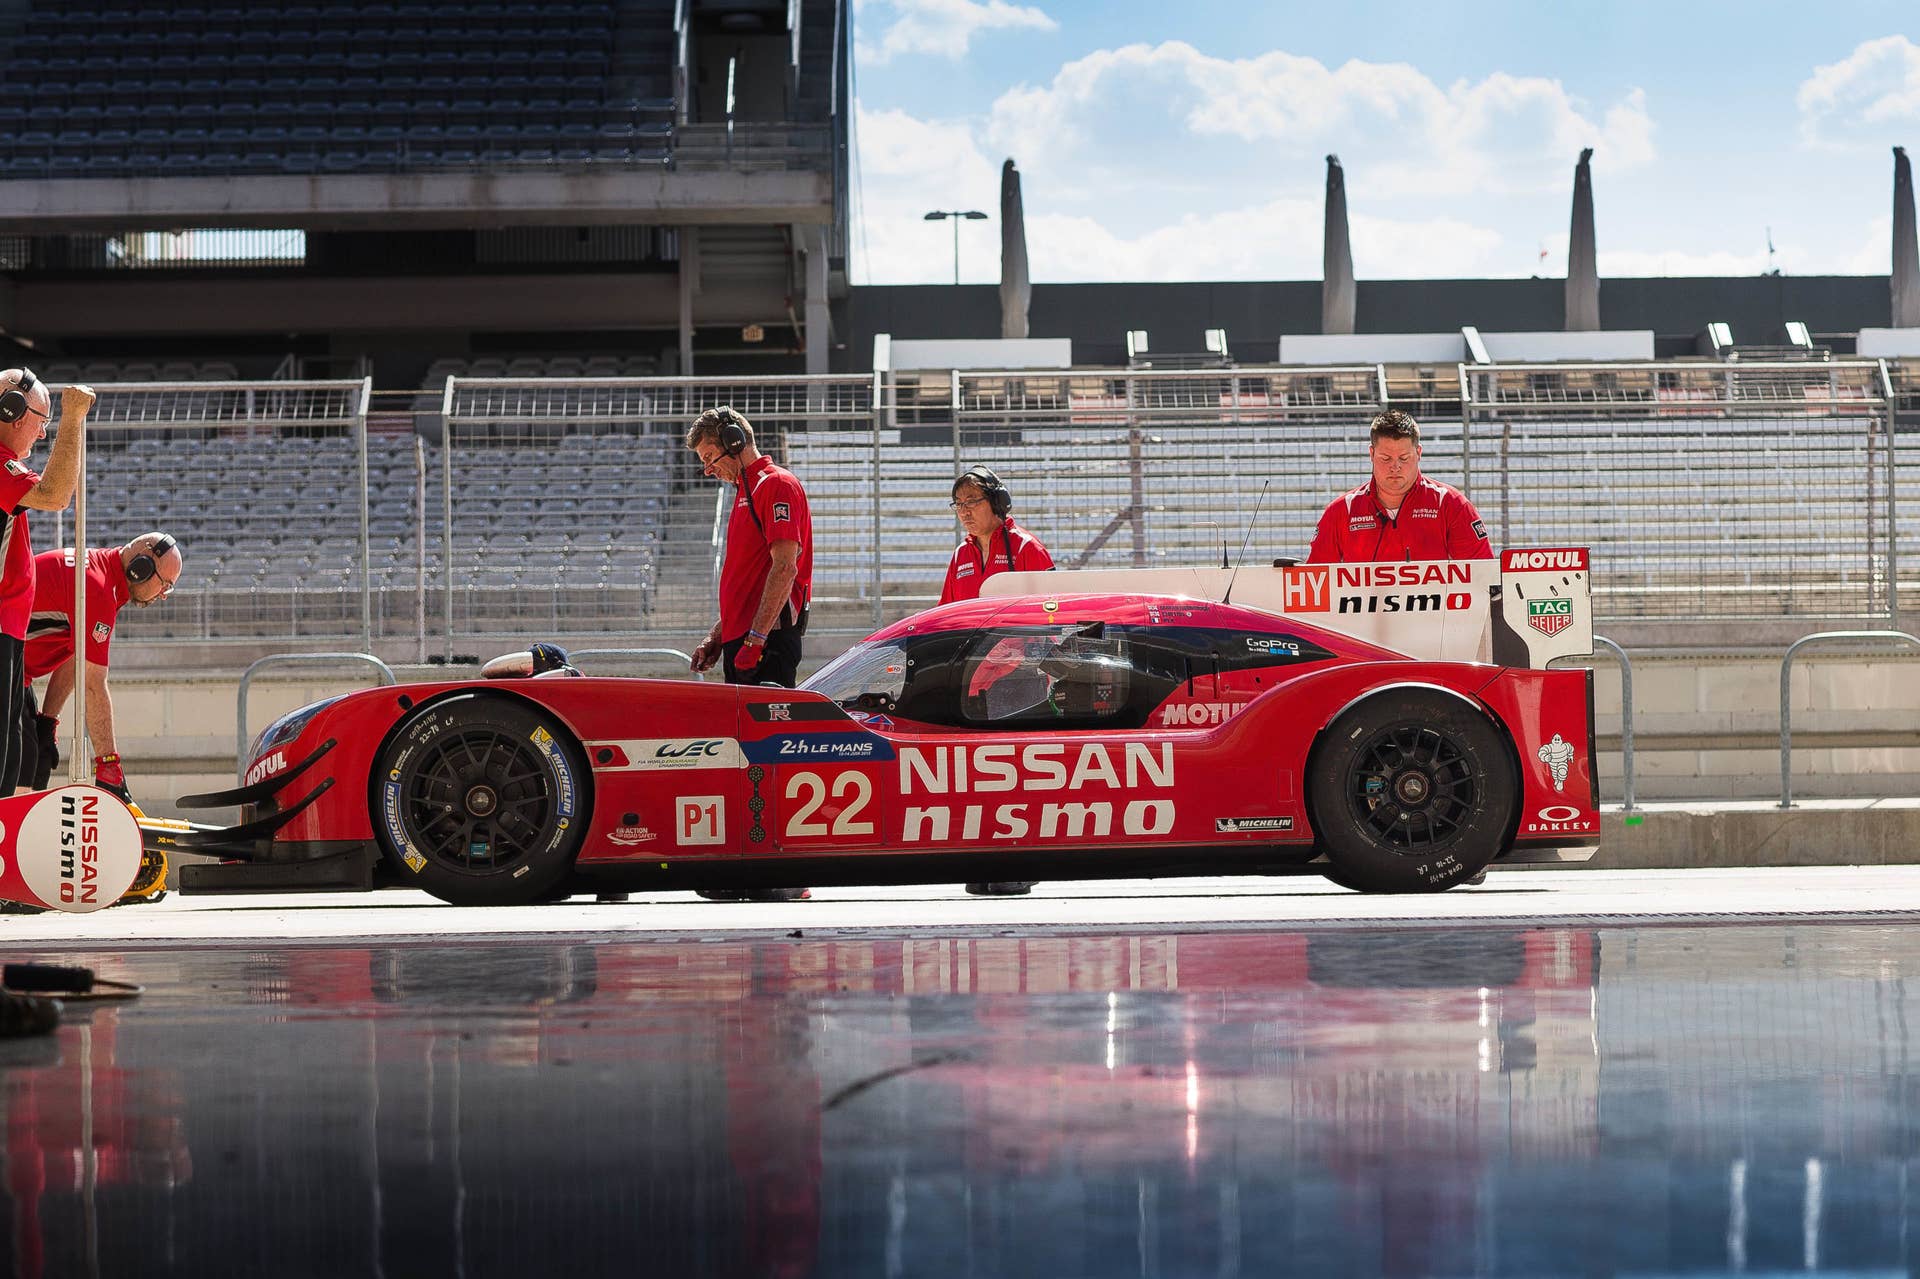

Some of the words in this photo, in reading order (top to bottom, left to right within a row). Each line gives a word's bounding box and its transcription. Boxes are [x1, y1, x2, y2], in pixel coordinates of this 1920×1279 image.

[1350, 515, 1374, 523] MOTUL
[1509, 551, 1582, 569] MOTUL
[1337, 563, 1471, 587] NISSAN
[1285, 571, 1328, 607] HY
[1338, 593, 1472, 613] nismo
[1531, 601, 1569, 614] TAG
[1531, 616, 1570, 633] HEUER
[1246, 638, 1299, 650] GoPro
[770, 709, 792, 720] R
[1162, 703, 1248, 725] MOTU
[655, 741, 724, 757] WEC
[811, 744, 829, 753] LE
[831, 743, 873, 752] MANS
[899, 742, 1174, 795] NISSAN
[552, 752, 572, 814] MICHELIN
[786, 770, 874, 837] 22
[387, 785, 406, 846] MICHELIN
[684, 803, 718, 838] P1
[902, 800, 1175, 842] nismo
[1239, 819, 1291, 827] MICHELIN
[1528, 821, 1591, 831] OAKLEY
[60, 795, 76, 903] nismo
[81, 796, 99, 904] NISSAN
